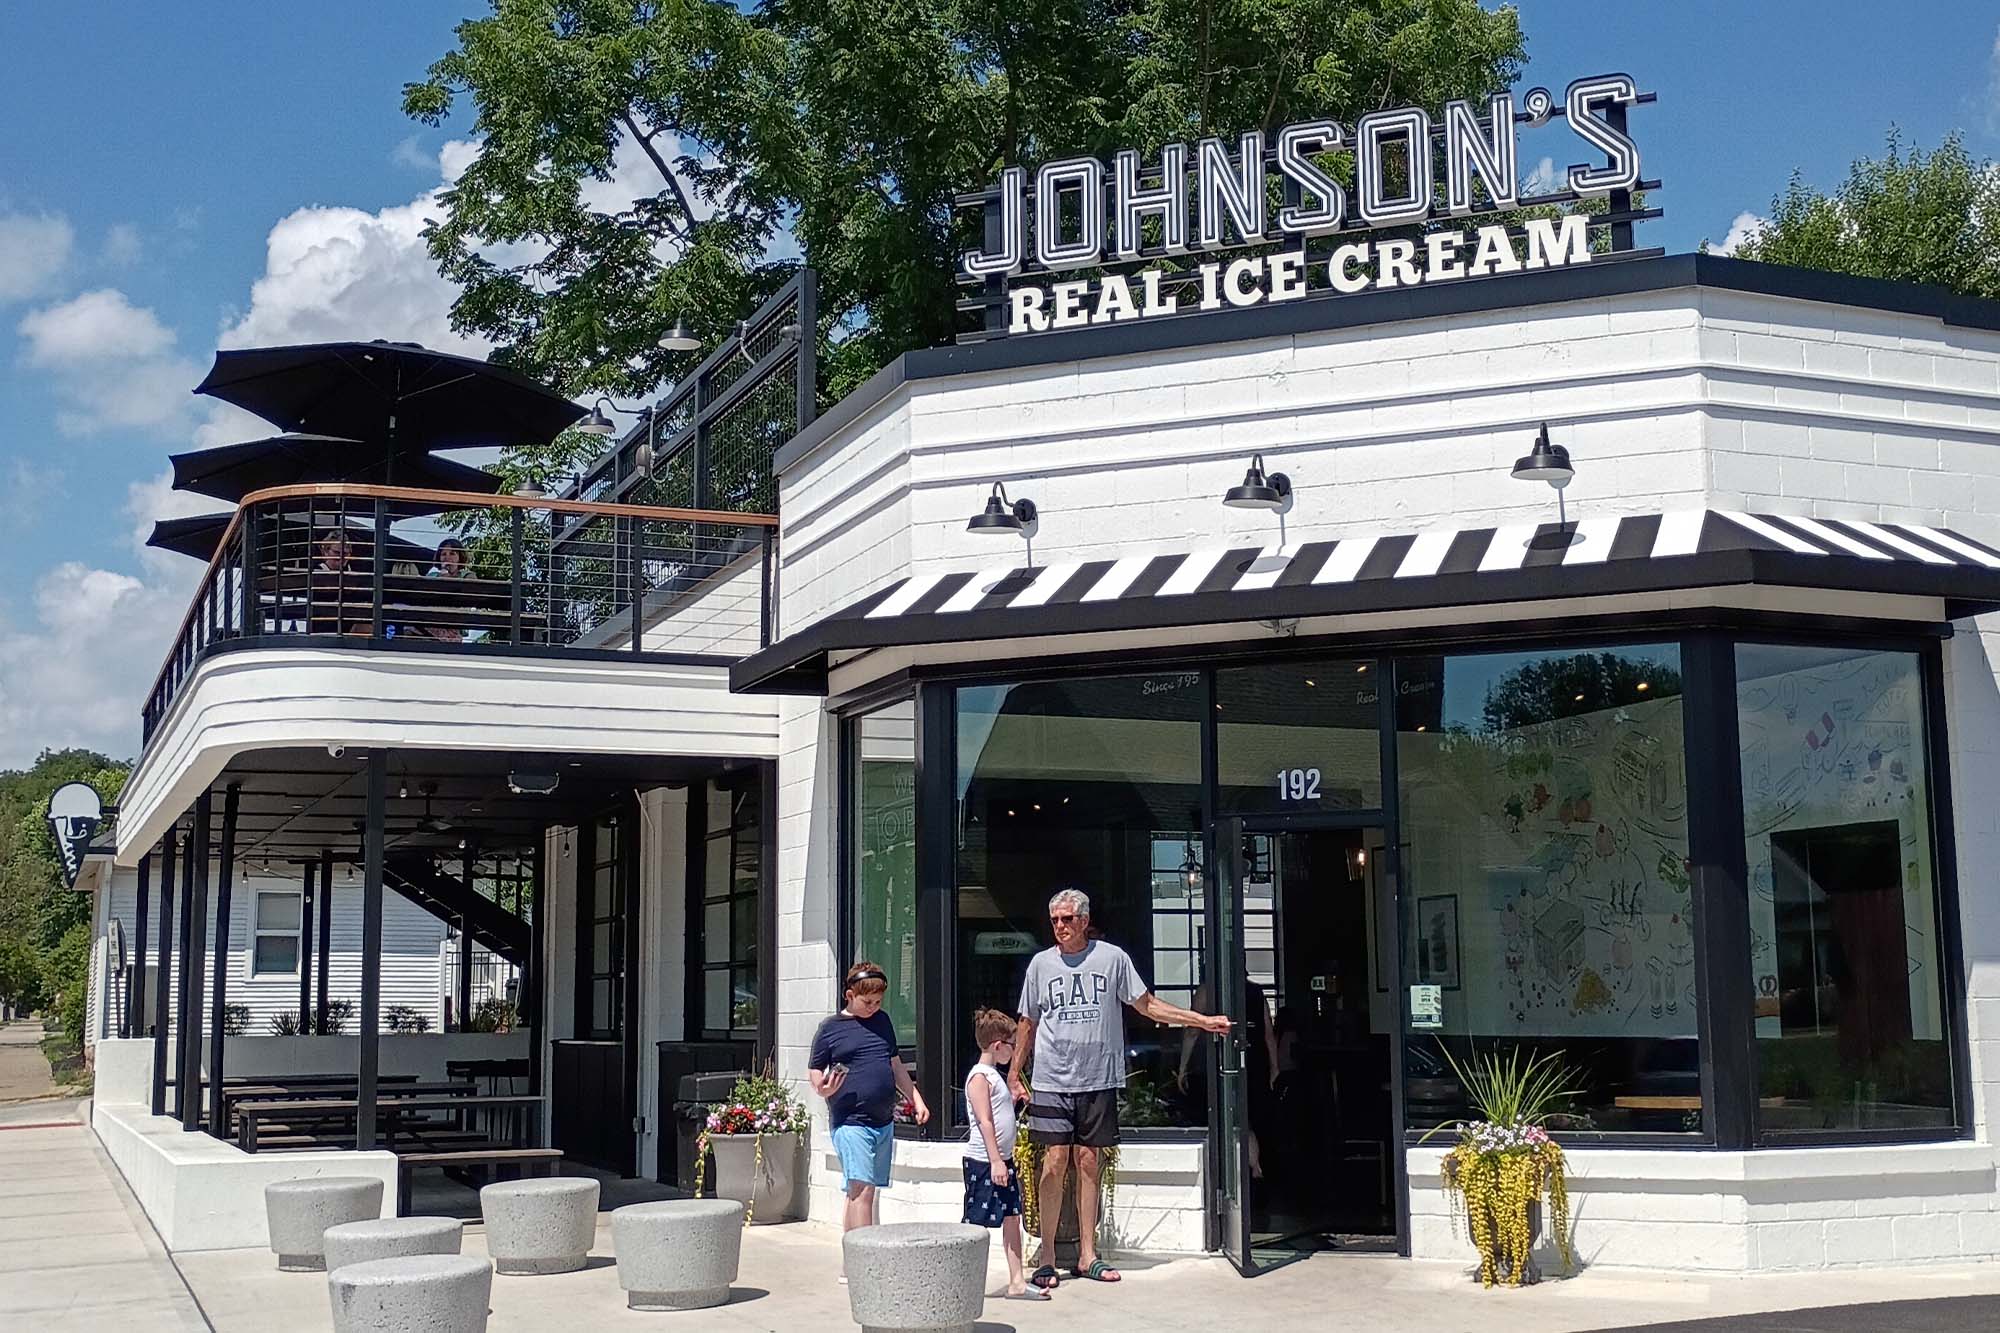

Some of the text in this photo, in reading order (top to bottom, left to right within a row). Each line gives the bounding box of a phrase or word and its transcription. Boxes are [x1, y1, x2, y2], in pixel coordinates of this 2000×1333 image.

[964, 73, 1641, 276] JOHNSON'S
[1008, 216, 1591, 334] REAL ICE CREAM
[1277, 768, 1321, 800] 192
[1047, 971, 1109, 1010] GAP
